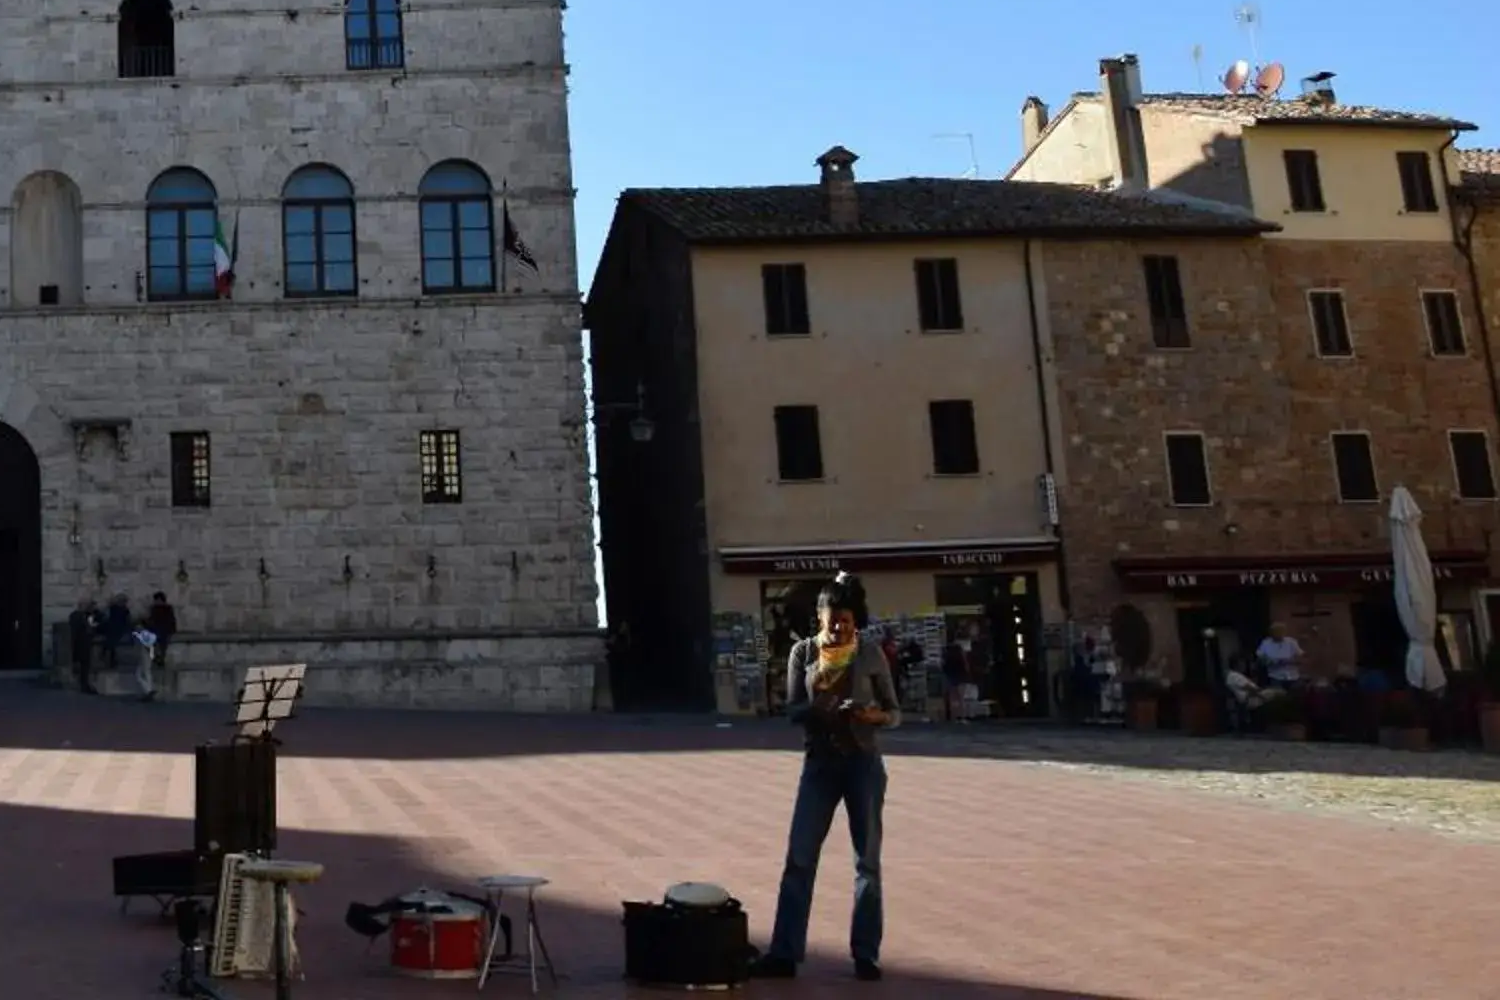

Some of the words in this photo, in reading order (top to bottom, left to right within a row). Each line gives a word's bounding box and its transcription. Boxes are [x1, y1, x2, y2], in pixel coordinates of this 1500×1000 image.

[774, 558, 840, 571] SOUVENIR
[1167, 575, 1198, 587] BAR
[1240, 572, 1319, 585] PIZZERIA
